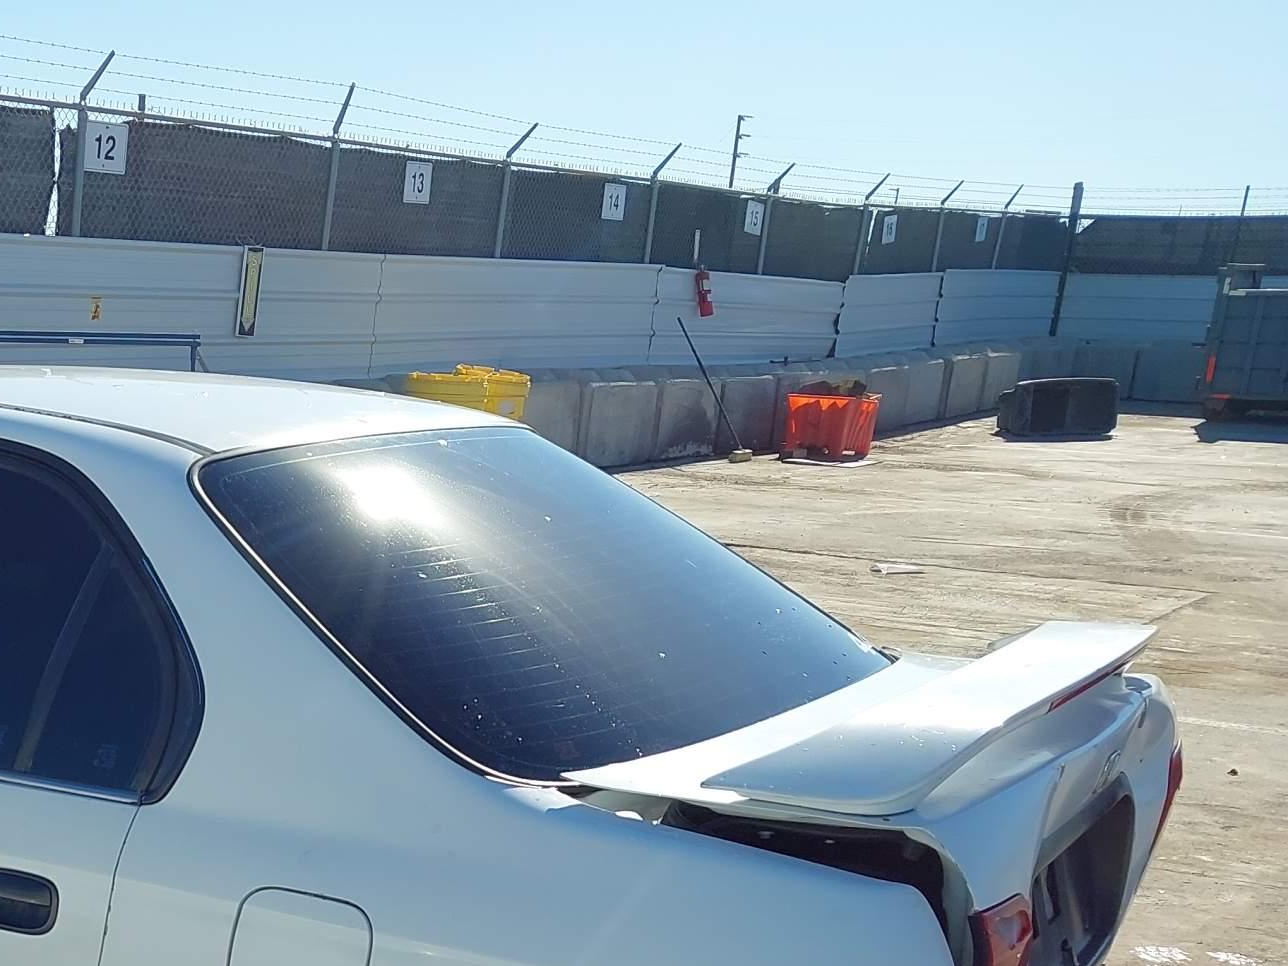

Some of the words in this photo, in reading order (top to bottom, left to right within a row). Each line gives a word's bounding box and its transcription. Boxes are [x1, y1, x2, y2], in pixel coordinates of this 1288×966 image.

[94, 133, 116, 161] 12
[412, 172, 425, 194] 13
[609, 193, 620, 211] 14
[750, 210, 759, 226] 15
